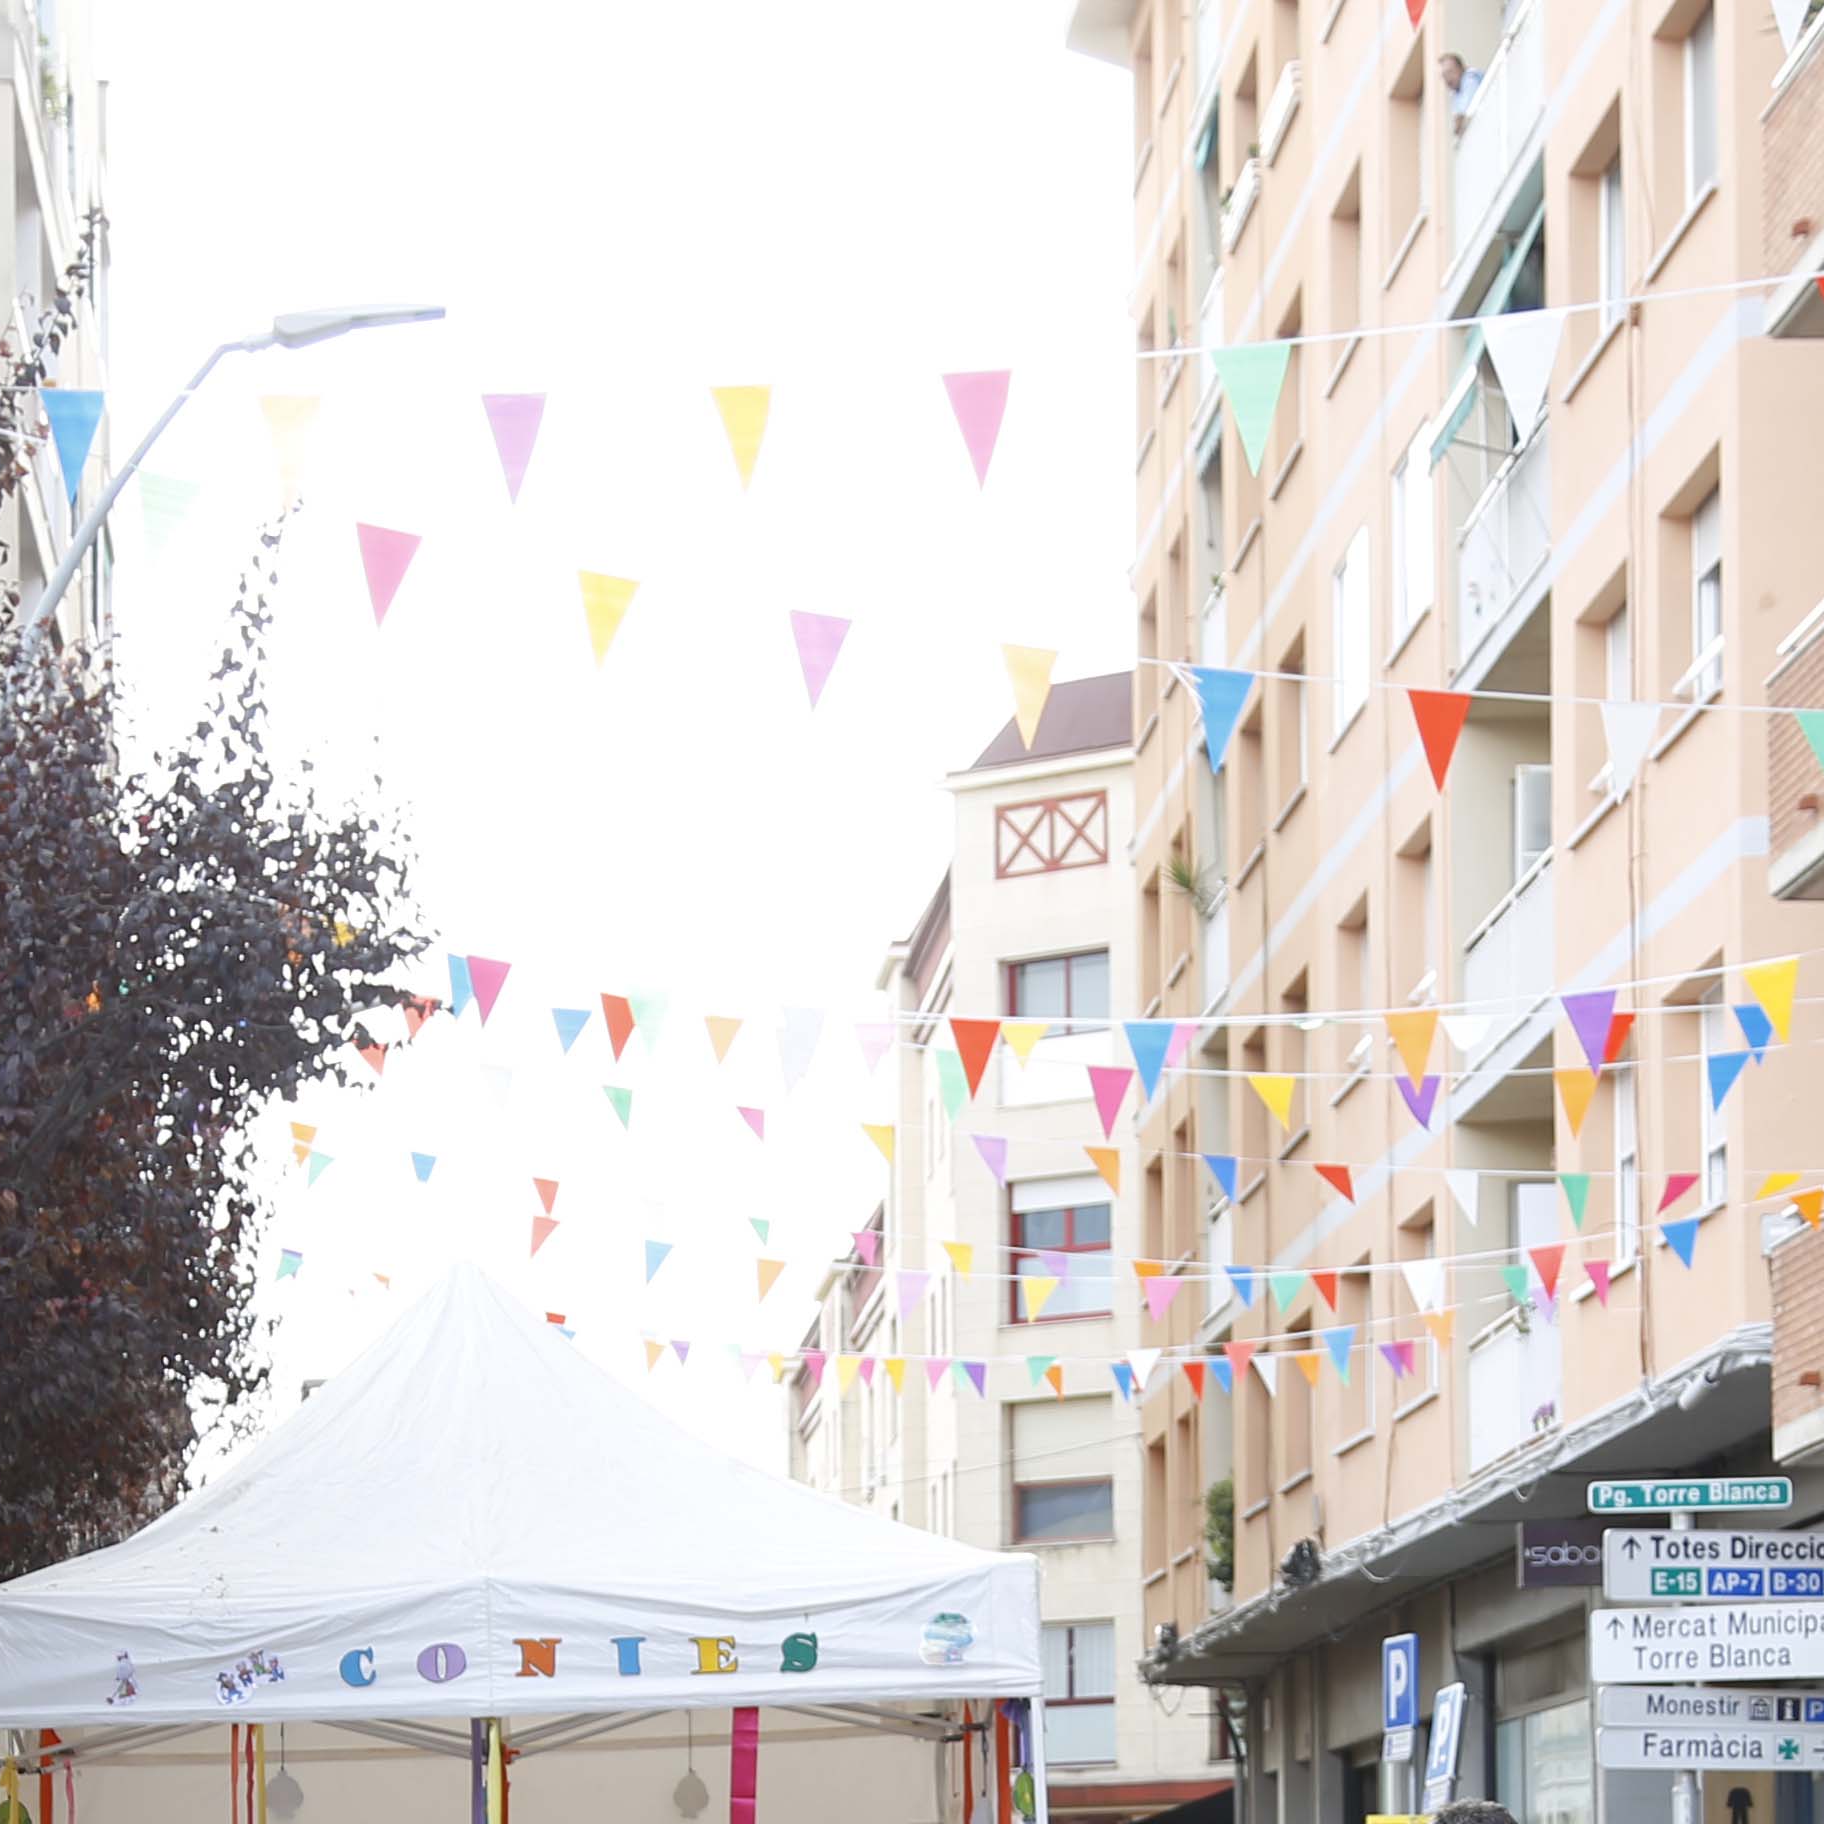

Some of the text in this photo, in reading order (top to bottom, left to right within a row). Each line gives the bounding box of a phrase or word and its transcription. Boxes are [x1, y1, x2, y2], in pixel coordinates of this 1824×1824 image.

[1598, 1482, 1781, 1507] Pg. Torre Blanca
[1651, 1536, 1720, 1559] Totes
[1654, 1571, 1821, 1593] E-15 AP-7 B-30
[1632, 1614, 1717, 1639] Mercat
[1634, 1643, 1792, 1671] Torre Blanca
[1646, 1694, 1740, 1716] Monestir
[1643, 1731, 1763, 1759] Farmàcia
